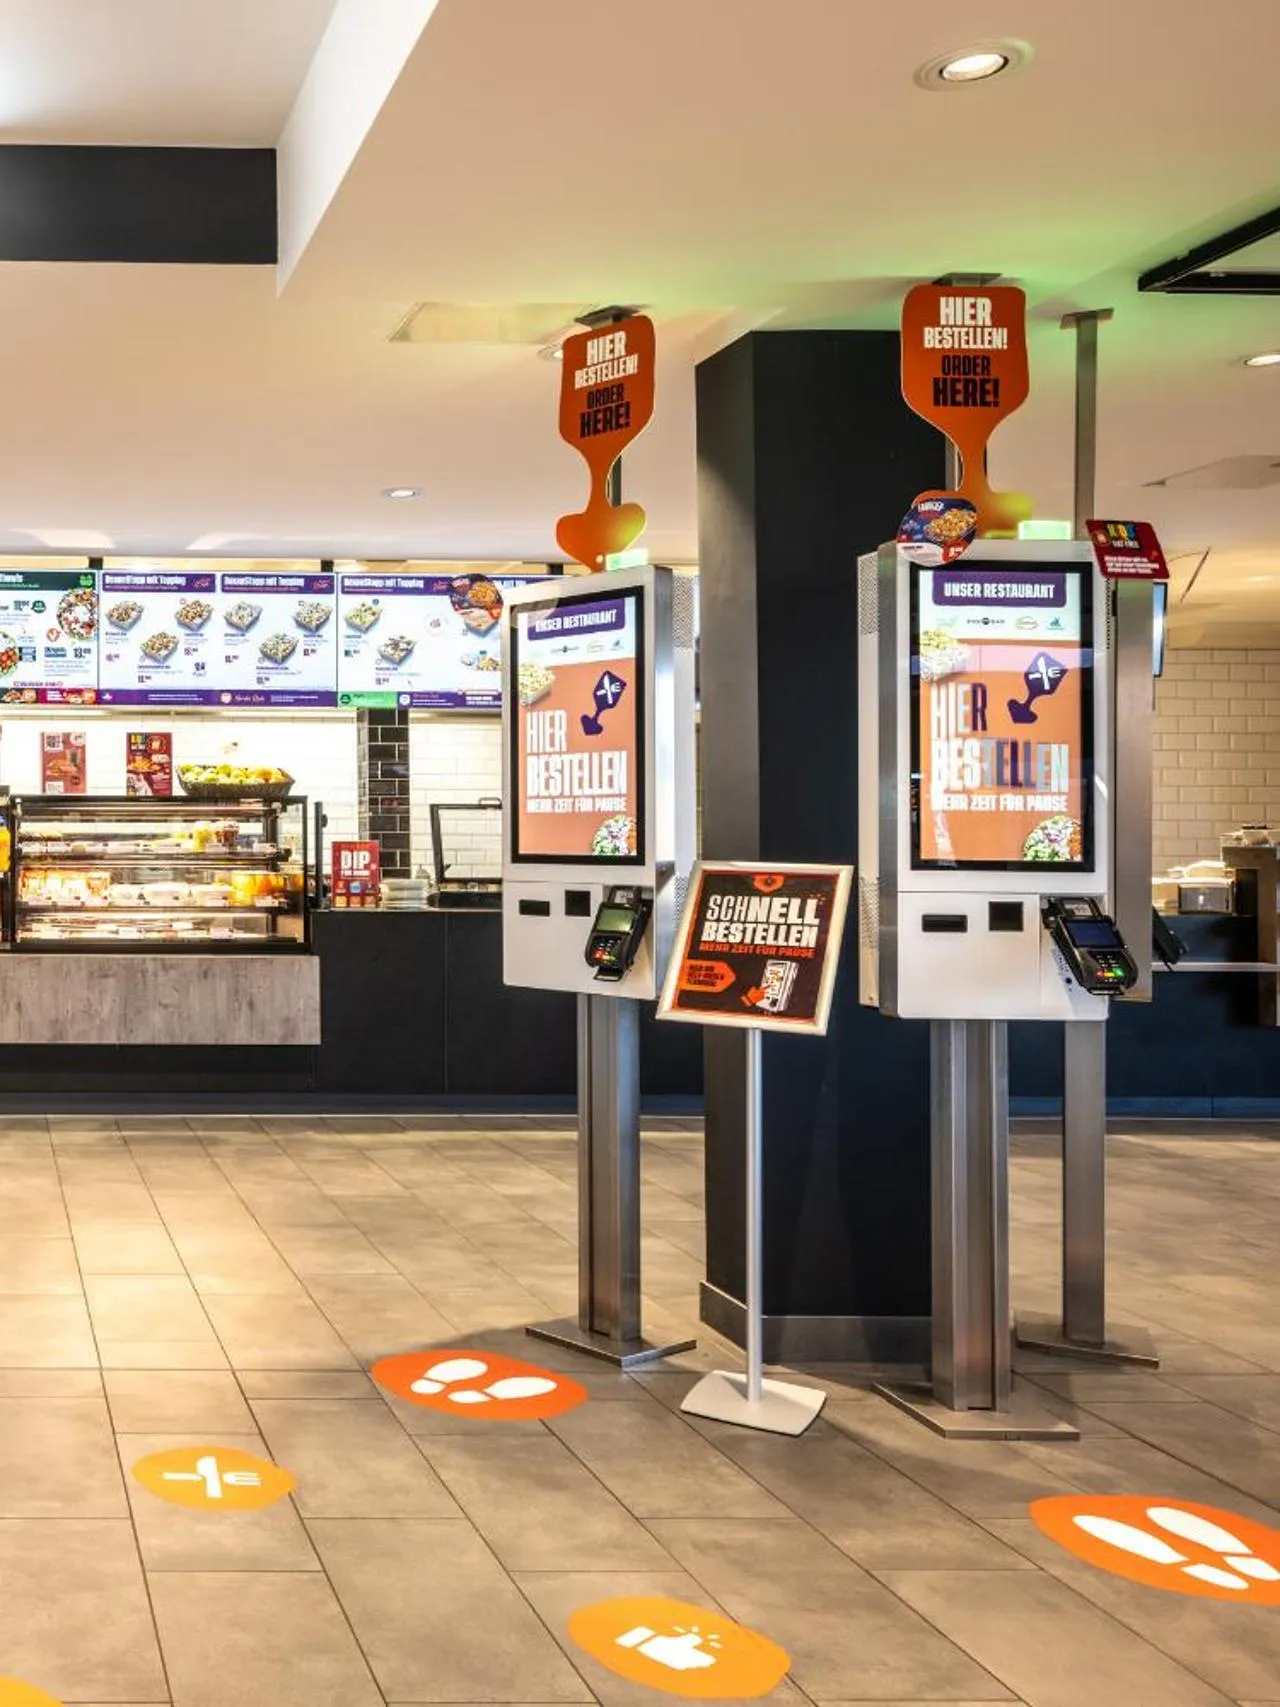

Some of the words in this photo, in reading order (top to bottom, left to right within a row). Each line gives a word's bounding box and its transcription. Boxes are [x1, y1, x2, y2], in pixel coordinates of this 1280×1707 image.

[939, 296, 993, 327] HIER
[586, 330, 627, 367] HIER
[923, 327, 1008, 349] BESTELLEN!
[574, 352, 638, 390] BESTELLEN!
[941, 354, 992, 377] ORDER
[586, 382, 625, 410] ORDER
[932, 377, 1000, 408] HERE!
[579, 401, 631, 439] HERE!
[944, 583, 981, 598] UNSER
[983, 583, 1055, 599] RESTAURANT
[535, 617, 562, 632] UNSER
[563, 609, 617, 629] RESTAURANT
[931, 682, 988, 737] HIER
[526, 709, 567, 753] HIER
[526, 750, 628, 797] BESTELLEN
[931, 738, 1069, 792] BESTELLEN
[554, 798, 574, 813] ZEIT
[595, 796, 628, 812] PAUSE
[932, 794, 969, 812] MEHR
[970, 795, 997, 811] ZEIT
[999, 793, 1024, 812] FÜR
[1026, 795, 1069, 812] PAUSE
[340, 850, 371, 870] DIP
[706, 894, 820, 925] SCHNELL
[700, 921, 819, 948] BESTELLEN
[700, 942, 731, 954] MEHR
[731, 944, 755, 954] ZEIT
[778, 947, 816, 959] PAUSE
